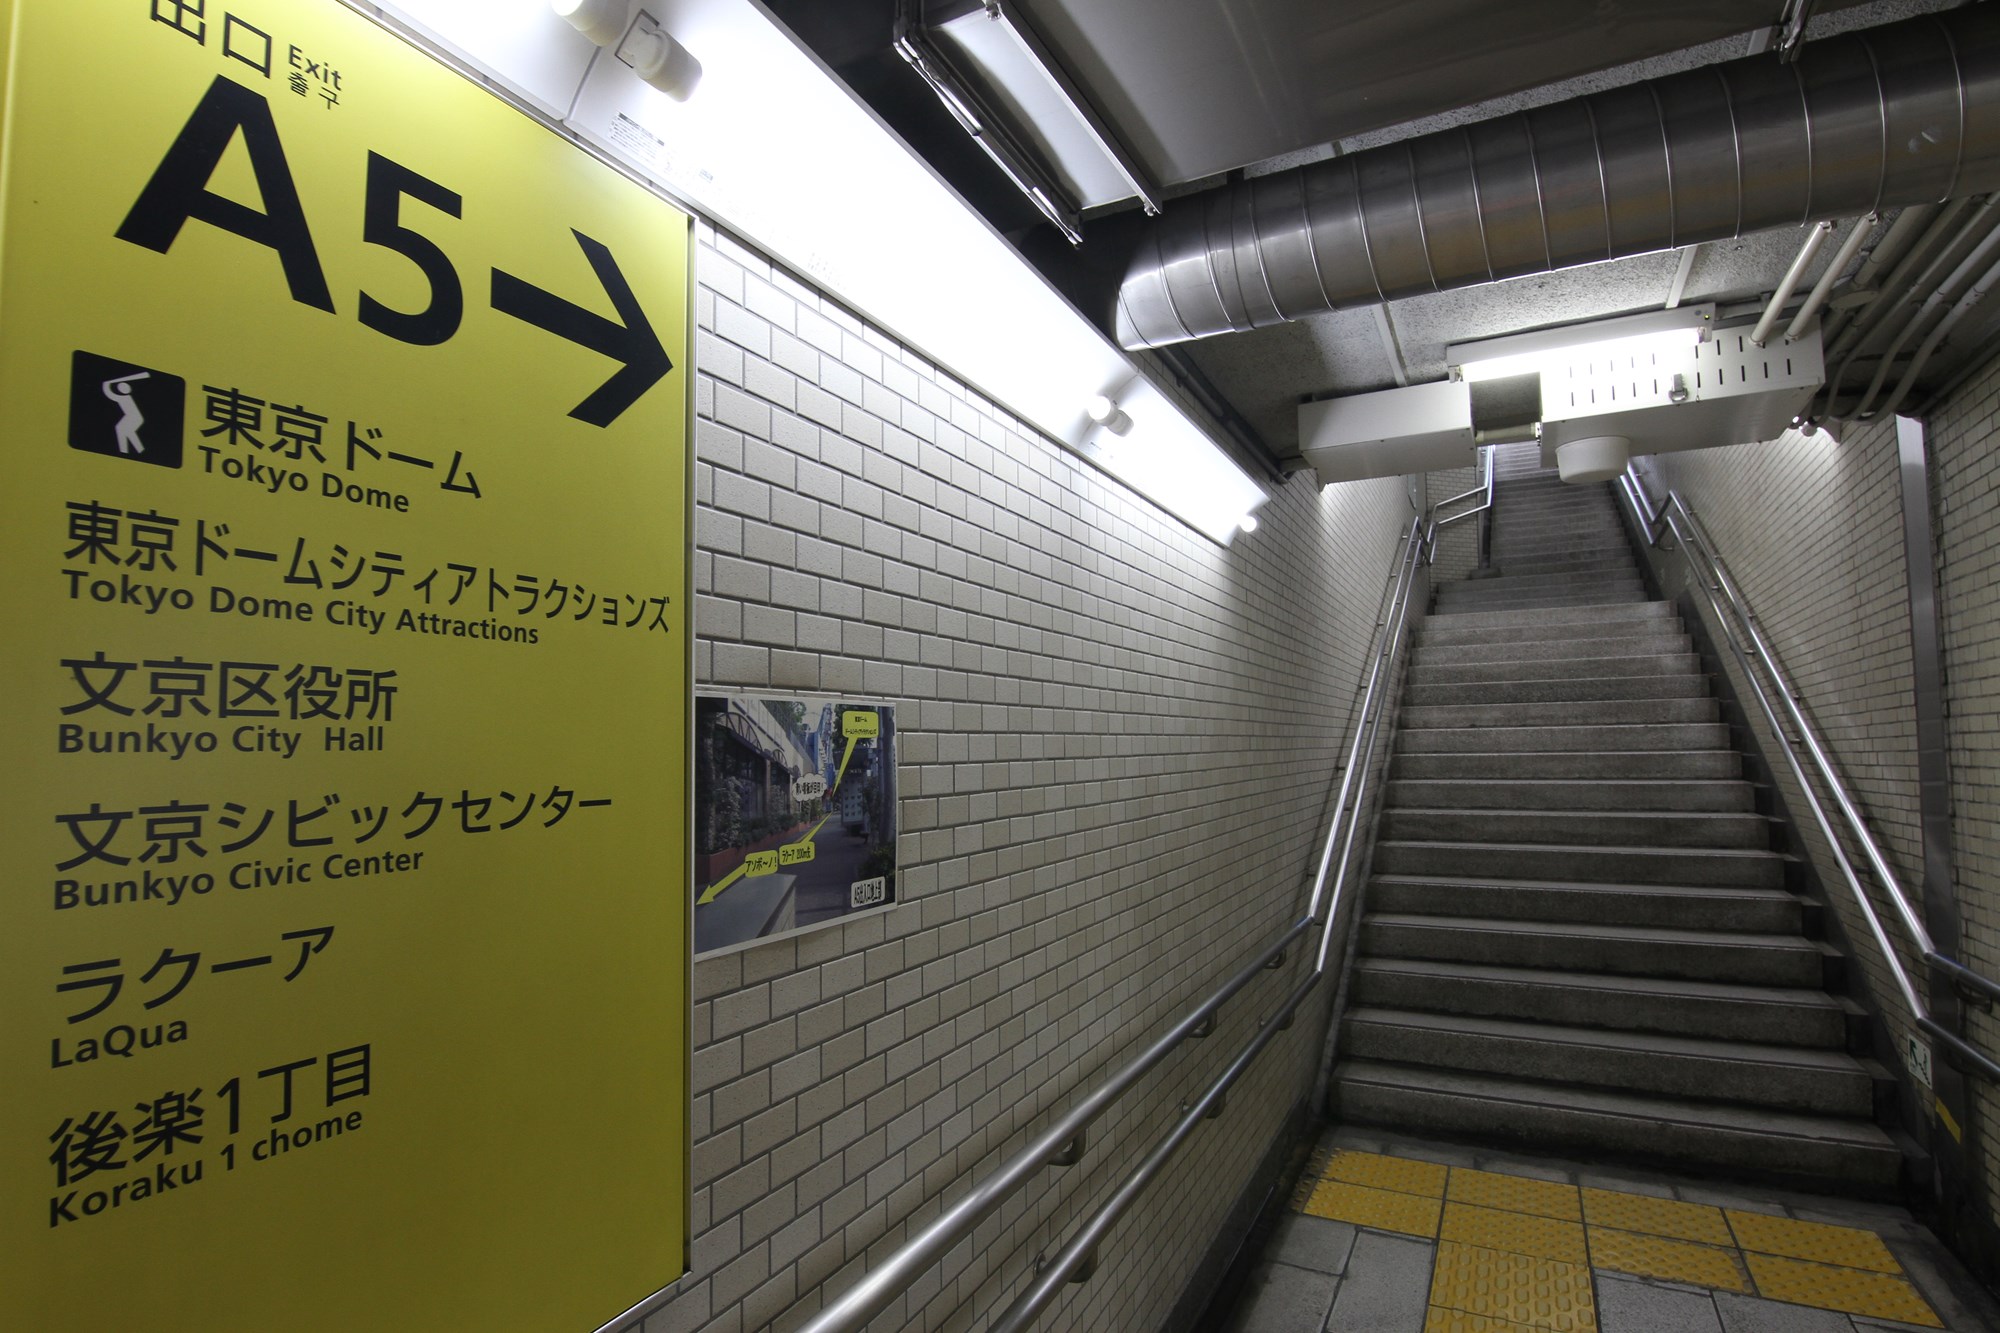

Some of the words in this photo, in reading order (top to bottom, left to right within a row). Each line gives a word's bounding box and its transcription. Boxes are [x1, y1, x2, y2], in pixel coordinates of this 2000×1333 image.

[150, 0, 272, 79] 出口
[288, 44, 342, 92] Exit
[114, 74, 463, 346] A5
[198, 445, 309, 492] Tokyo
[321, 472, 409, 513] Dome
[200, 384, 482, 499] 東京ドーム
[61, 568, 194, 616] Tokyo
[209, 586, 314, 622] Dome
[325, 600, 387, 636] City
[395, 607, 539, 645] Attractions
[62, 500, 669, 634] 東京ドームシティアトラクションズ
[59, 652, 398, 722] 文京区役所
[58, 723, 218, 760] Bunkyo
[232, 725, 302, 759] City
[324, 726, 384, 752] Hall
[54, 786, 612, 873] 文京シビックセンター
[54, 870, 215, 911] Bunkyo
[229, 862, 312, 891] Civic
[323, 850, 424, 880] Center
[56, 926, 335, 1025] ラクーア
[51, 1021, 188, 1069] LaQua
[48, 1043, 372, 1188] 後楽1丁目
[49, 1160, 203, 1229] Koraku
[220, 1143, 235, 1171] 1
[252, 1110, 363, 1162] chome
